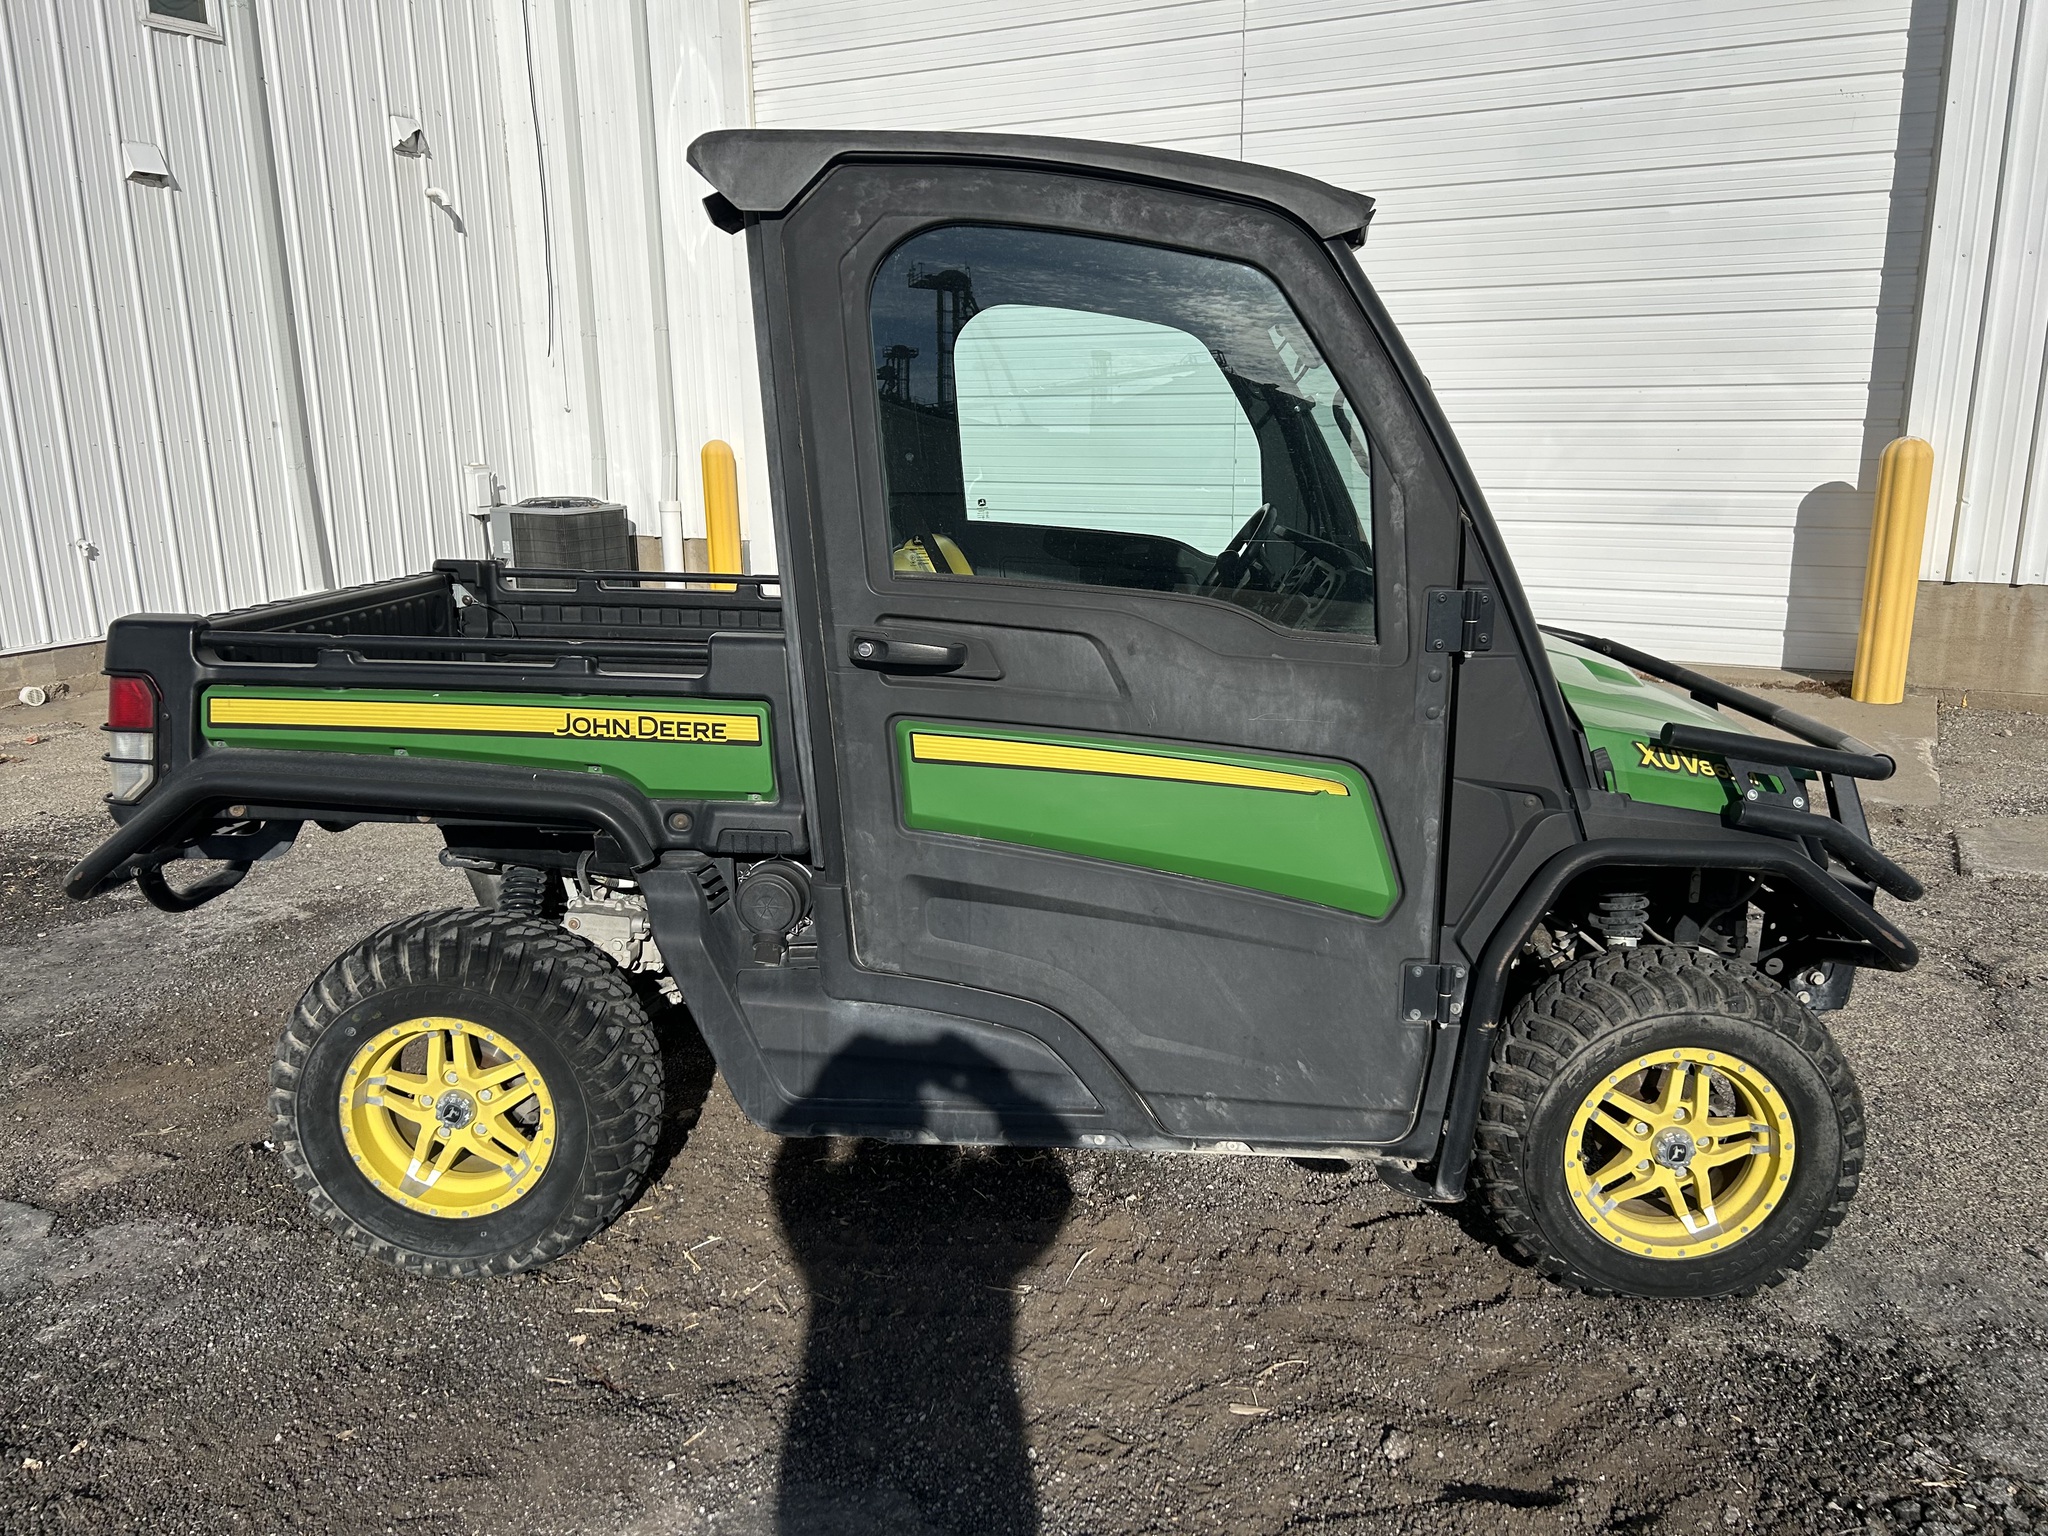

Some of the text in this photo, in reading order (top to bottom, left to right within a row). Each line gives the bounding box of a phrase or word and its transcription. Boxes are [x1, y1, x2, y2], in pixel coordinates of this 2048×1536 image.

[557, 713, 727, 740] JOHN DEERE
[1633, 741, 1760, 786] XUV86
